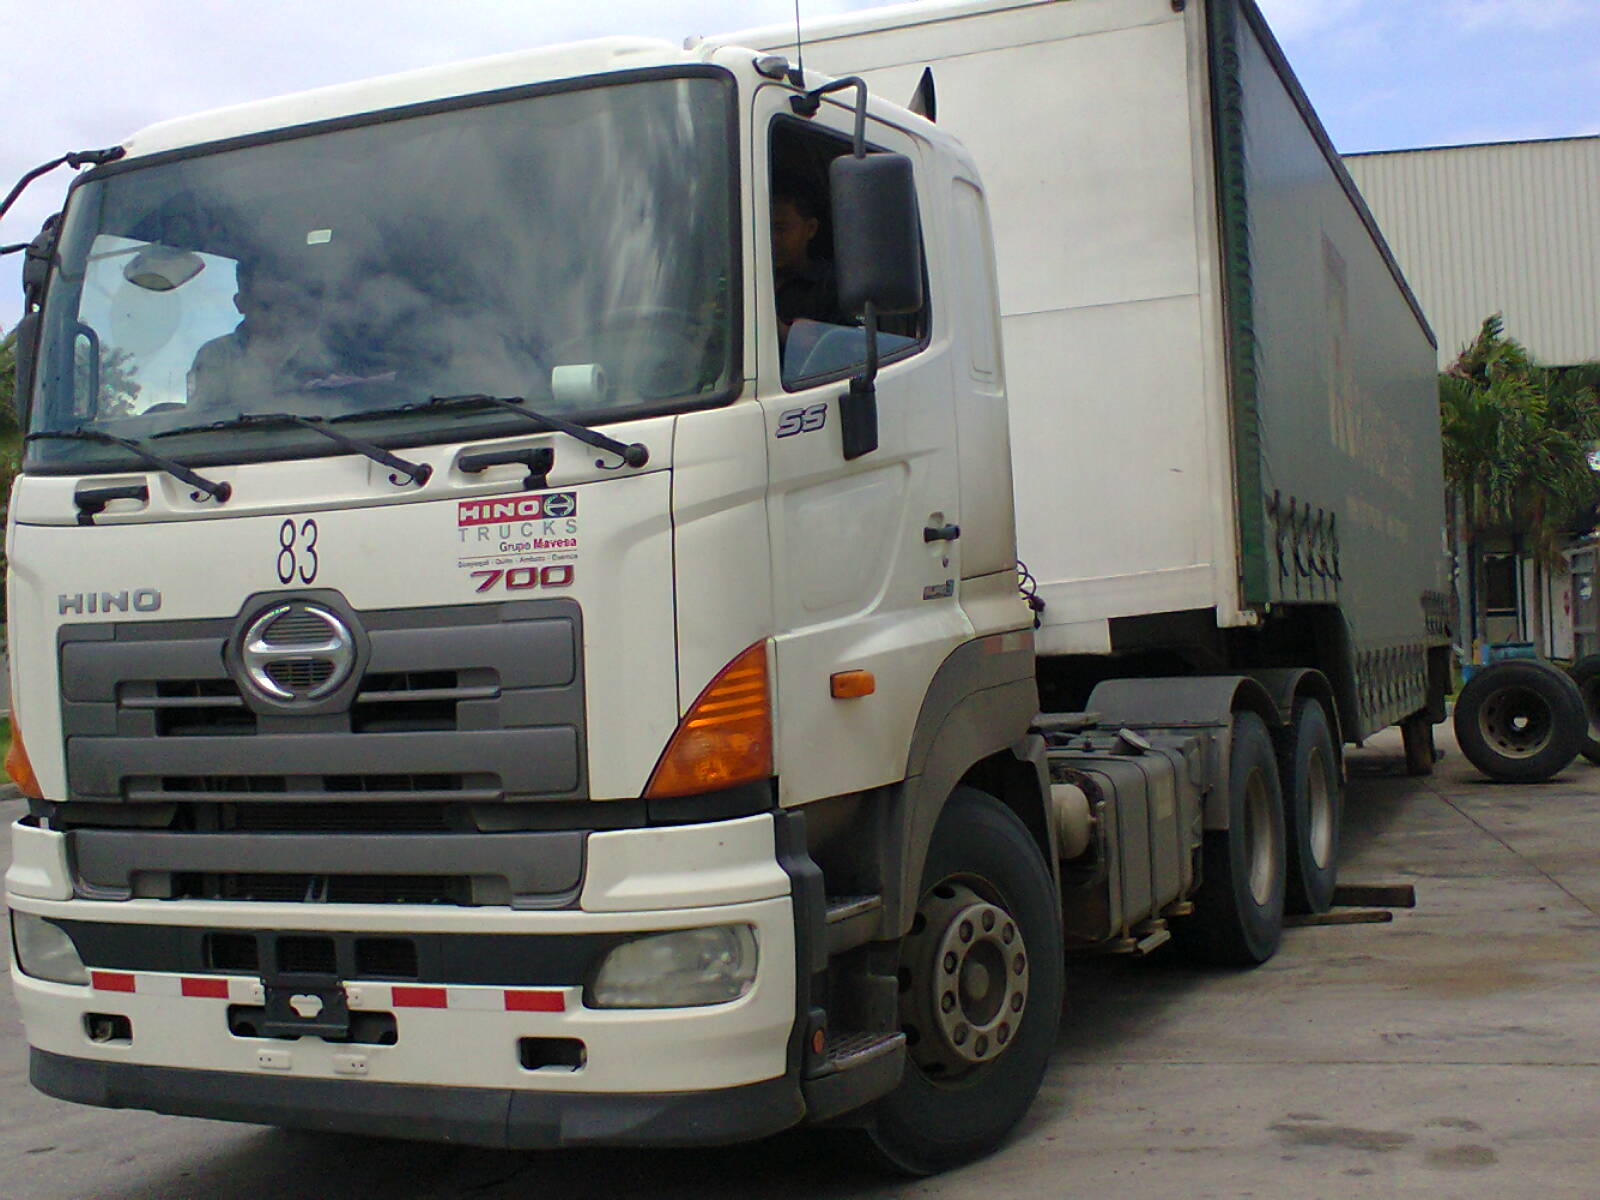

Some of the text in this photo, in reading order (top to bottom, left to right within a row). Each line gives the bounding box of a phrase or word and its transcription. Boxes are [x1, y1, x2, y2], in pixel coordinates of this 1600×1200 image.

[775, 403, 828, 439] SS
[459, 500, 540, 521] HINO
[458, 519, 577, 542] TRUCKS
[277, 519, 319, 584] 83
[499, 541, 532, 552] Grupo
[470, 565, 575, 593] 700
[58, 588, 162, 615] HINO
